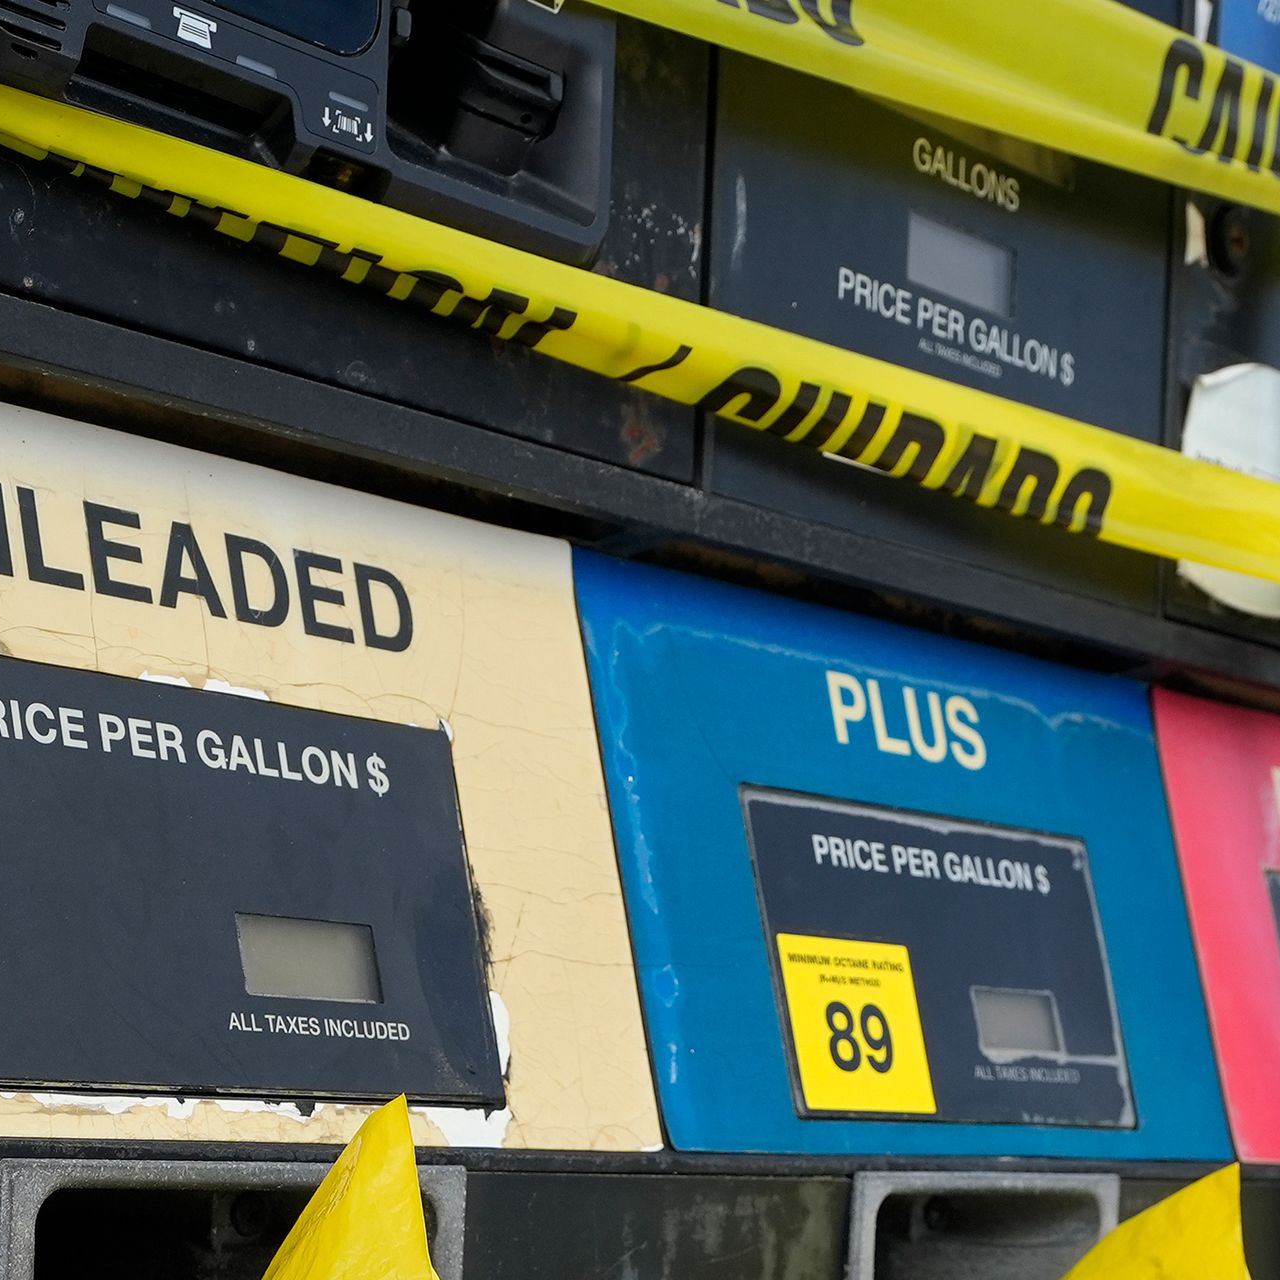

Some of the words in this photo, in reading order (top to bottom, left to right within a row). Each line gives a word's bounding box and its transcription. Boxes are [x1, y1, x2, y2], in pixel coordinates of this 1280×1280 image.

[913, 137, 1020, 212] GALLONS
[838, 266, 912, 325] PRICE
[916, 297, 965, 345] PER
[969, 318, 1058, 379] GALLON
[1059, 352, 1075, 387] $
[98, 712, 187, 764] PER
[196, 729, 359, 789] GALLON
[367, 752, 390, 798] $
[827, 670, 987, 770] PLUS
[812, 834, 889, 873] PRICE
[891, 844, 941, 880] PER
[943, 852, 1033, 891] GALLON
[1034, 864, 1051, 896] $
[229, 1012, 263, 1032] ALL
[264, 1014, 320, 1036] TAXES
[324, 1018, 410, 1041] INCLUDED
[826, 1001, 893, 1073] 89
